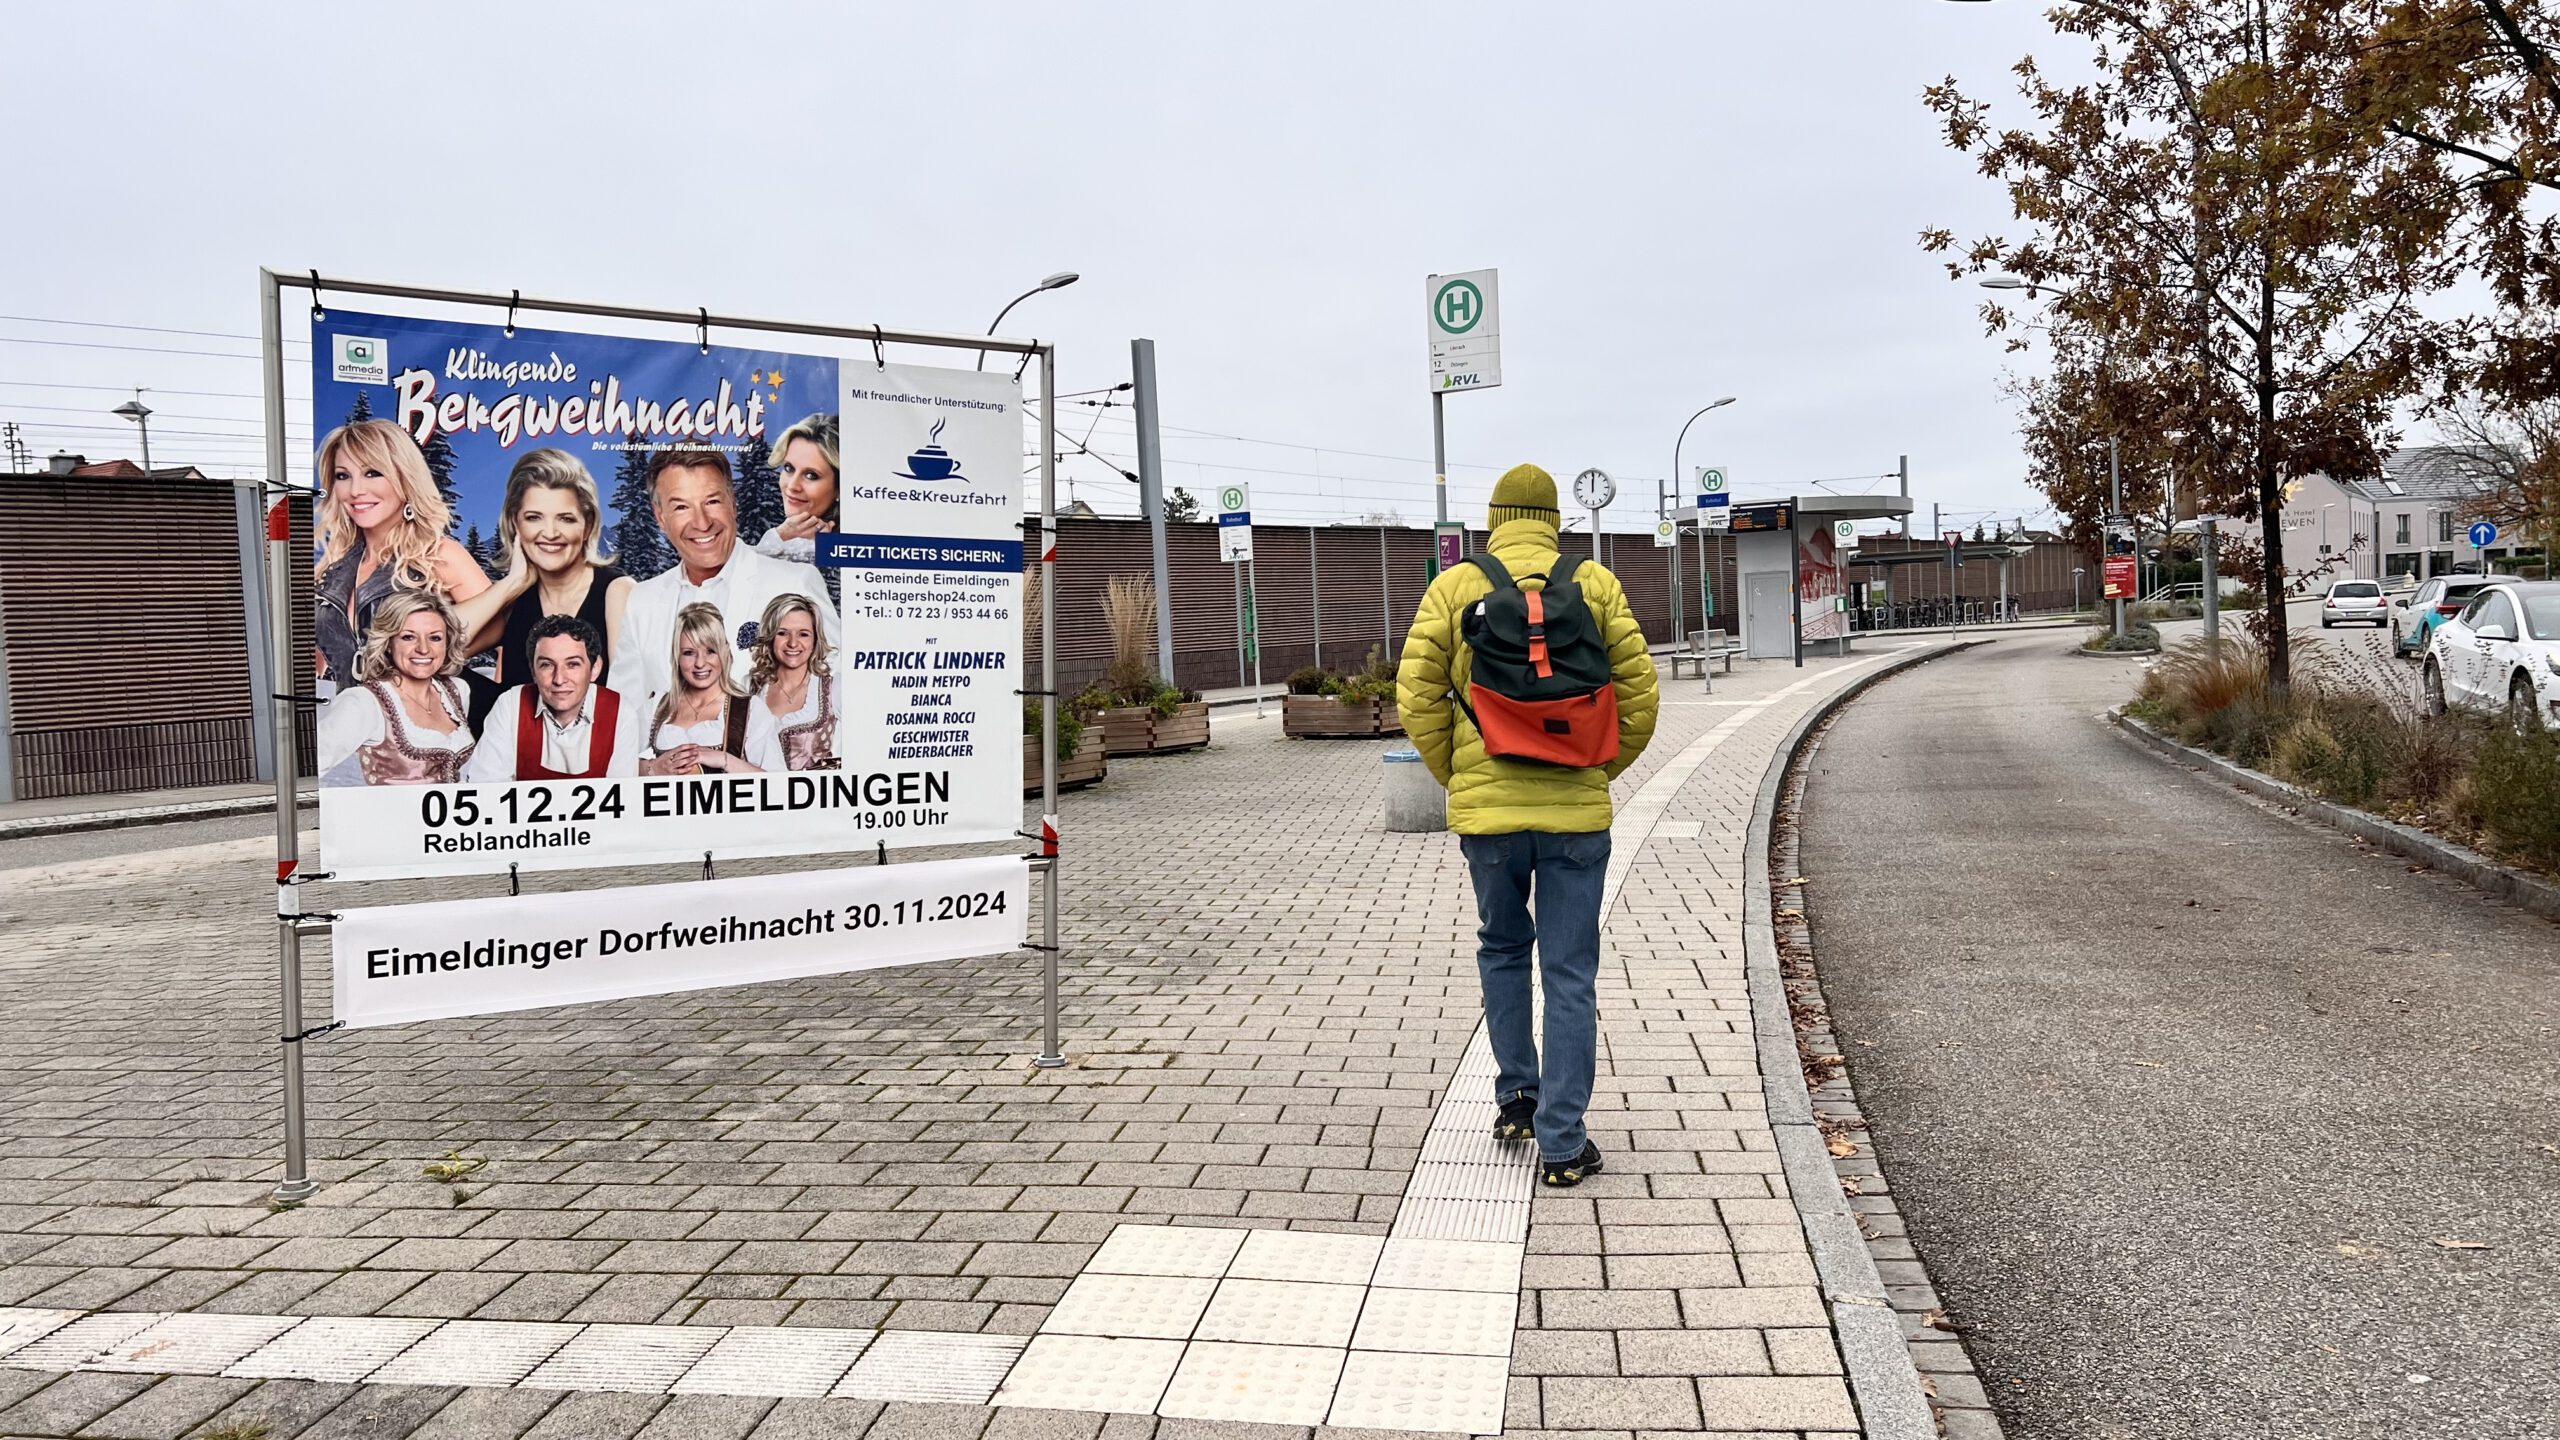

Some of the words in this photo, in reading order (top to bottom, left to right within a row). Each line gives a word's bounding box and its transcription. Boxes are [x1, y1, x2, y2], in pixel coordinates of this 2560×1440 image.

[338, 364, 383, 375] artmedia
[445, 347, 577, 388] Klingende
[1434, 360, 1442, 368] 12
[1452, 373, 1480, 386] RVL
[852, 388, 867, 400] Mit
[871, 391, 932, 405] freundlicher
[935, 396, 1007, 412] Unterstützung:
[393, 367, 765, 449] Bergweihnacht
[592, 441, 607, 451] Die
[610, 441, 673, 452] volkstümliche
[675, 442, 752, 452] Weihnachtsrevue!
[853, 486, 1007, 506] Kaffee&Kreuzfahrt
[2294, 509, 2315, 517] Hotel
[830, 544, 874, 559] JETZT
[878, 546, 937, 561] TICKETS
[941, 549, 1005, 563] SICHERN:
[864, 571, 929, 585] Gemeinde
[933, 573, 1010, 589] Eimeldingen
[864, 590, 996, 604] schlagershop24.com
[864, 607, 892, 618] Tel.:
[896, 608, 903, 618] 0
[907, 608, 922, 618] 72
[926, 608, 941, 618] 23
[951, 608, 973, 619] 953
[976, 609, 991, 619] 44
[994, 609, 1009, 620] 66
[926, 637, 938, 645] MIT
[854, 651, 927, 670] PATRICK
[933, 651, 1006, 670] LINDNER
[891, 676, 928, 688] NADIN
[932, 675, 971, 688] MEYPO
[911, 694, 952, 706] BIANCA
[886, 712, 939, 725] ROSANNA
[943, 711, 976, 724] ROCCI
[892, 730, 969, 744] GESCHWISTER
[888, 745, 973, 759] NIEDERBACHER
[421, 783, 625, 828] 05.12.24
[643, 770, 949, 817] EIMELDINGEN
[853, 810, 906, 829] 19.00
[913, 808, 949, 826] Uhr
[424, 827, 591, 853] Reblandhalle
[367, 938, 588, 979] Eimeldinger
[600, 908, 835, 956] Dorfweihnacht
[843, 890, 1007, 930] 30.11.2024
